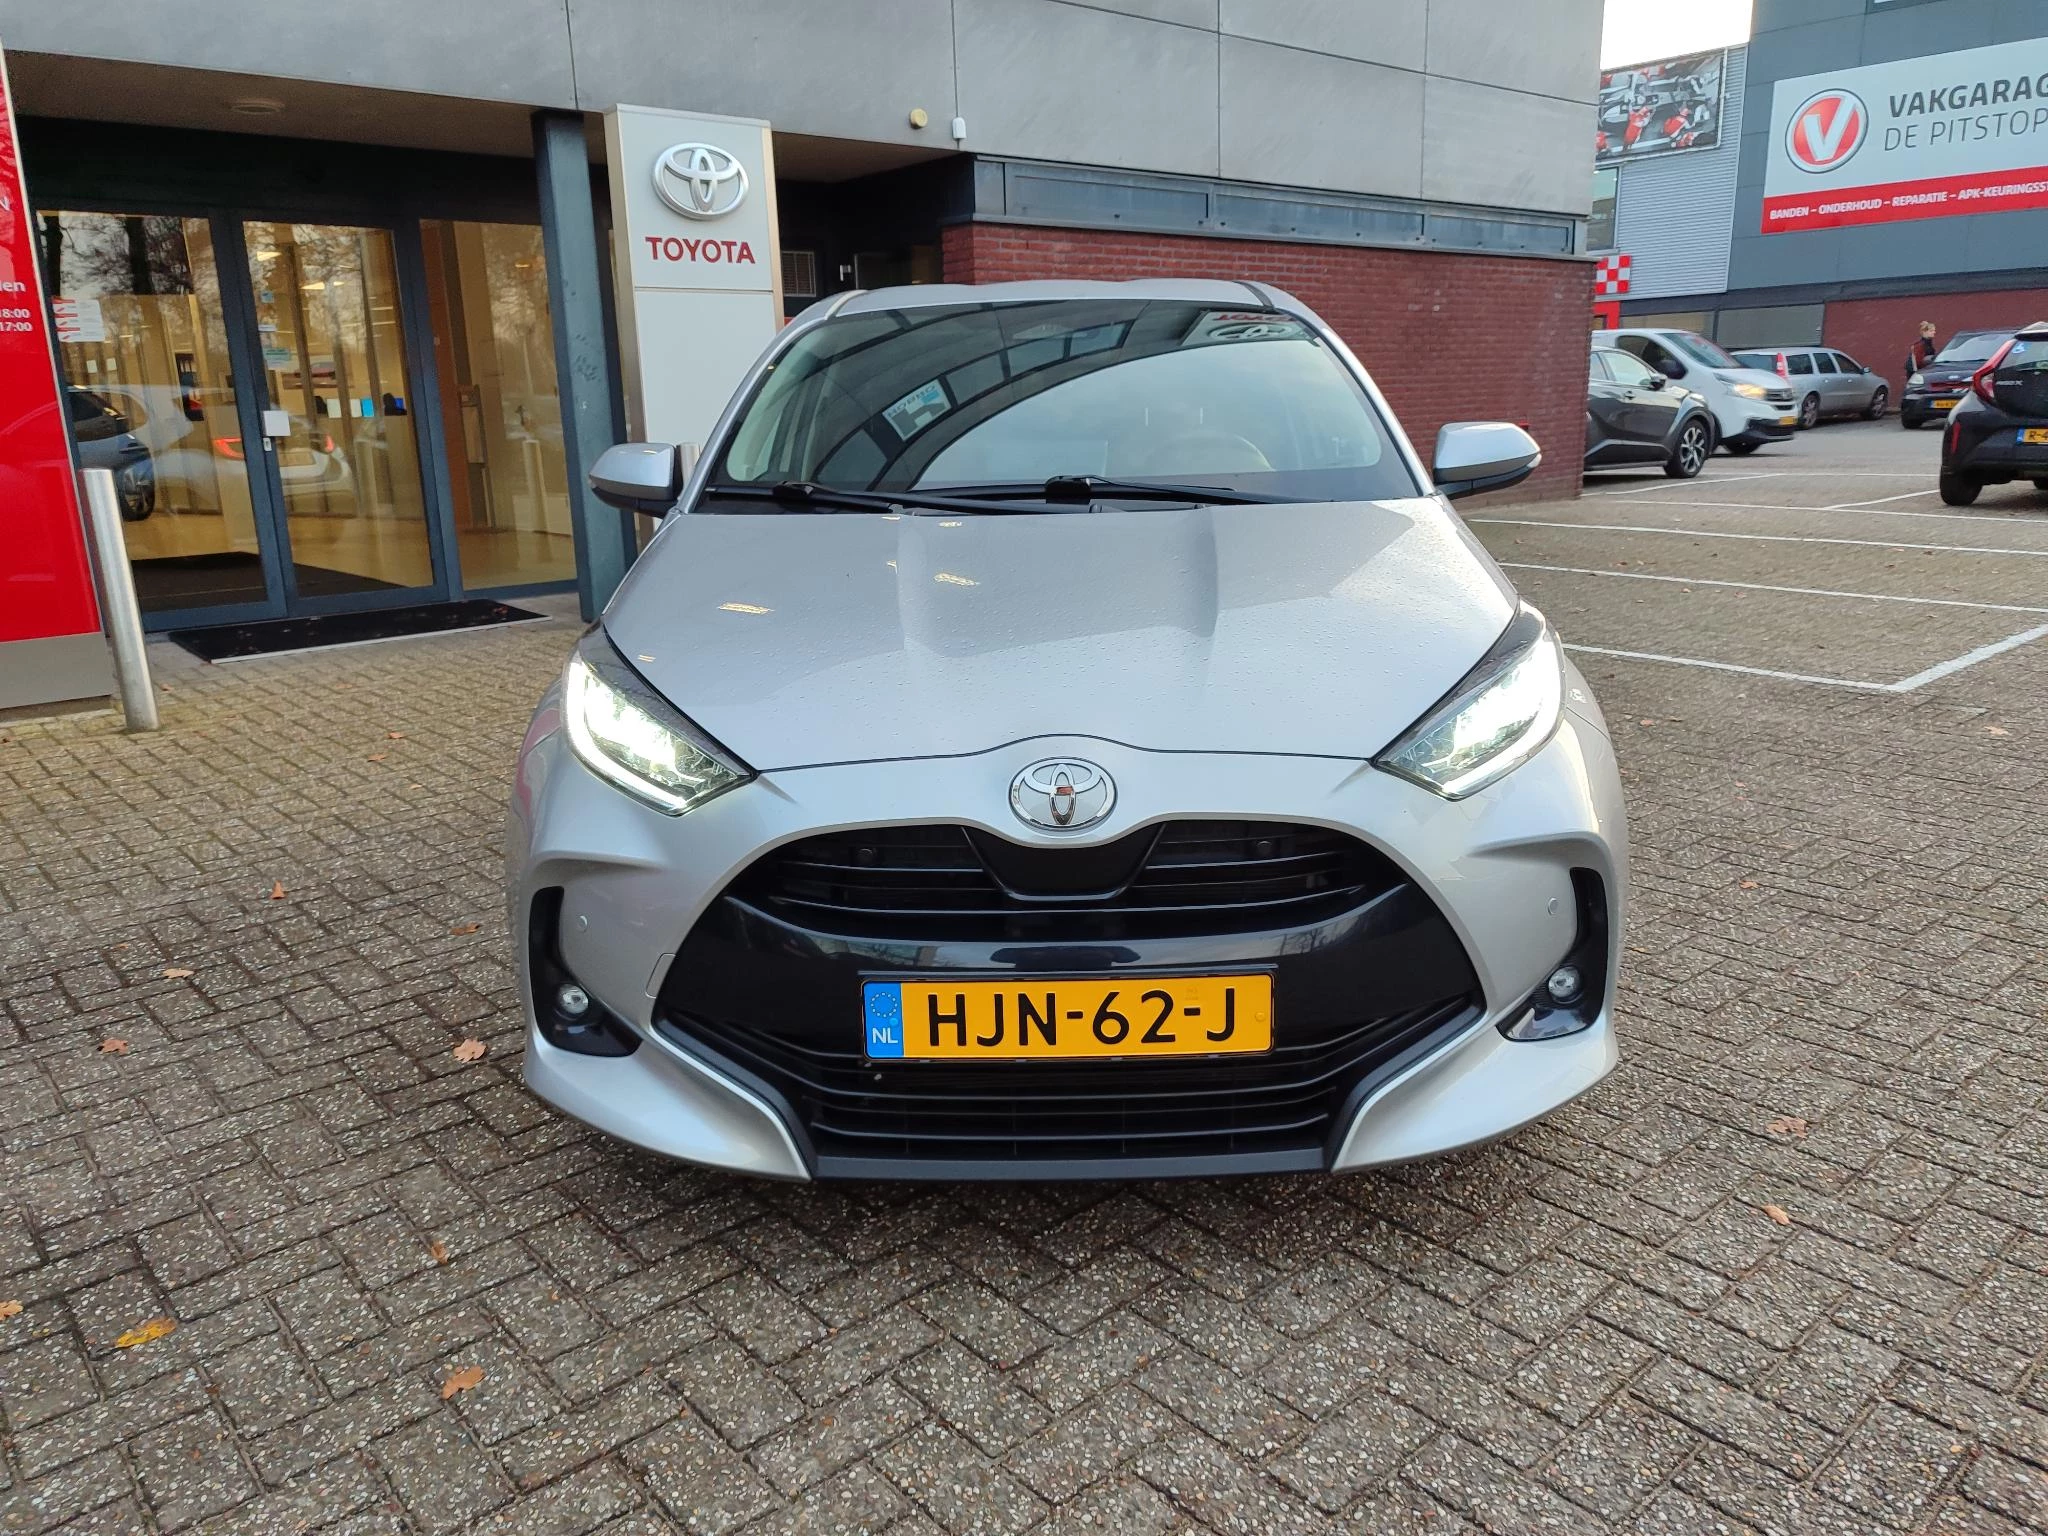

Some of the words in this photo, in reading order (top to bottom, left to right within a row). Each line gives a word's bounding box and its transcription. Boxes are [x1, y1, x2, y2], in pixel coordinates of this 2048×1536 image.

[1884, 124, 1919, 151] DE
[1930, 107, 2048, 145] PITSTOP
[1769, 206, 1809, 220] BANDEN
[1818, 198, 1882, 214] ONDERHOUD
[1892, 191, 1948, 207] REPARATIE
[645, 236, 756, 264] TOYOTA
[928, 987, 1235, 1047] HJN-62-J
[872, 1027, 899, 1044] NL
